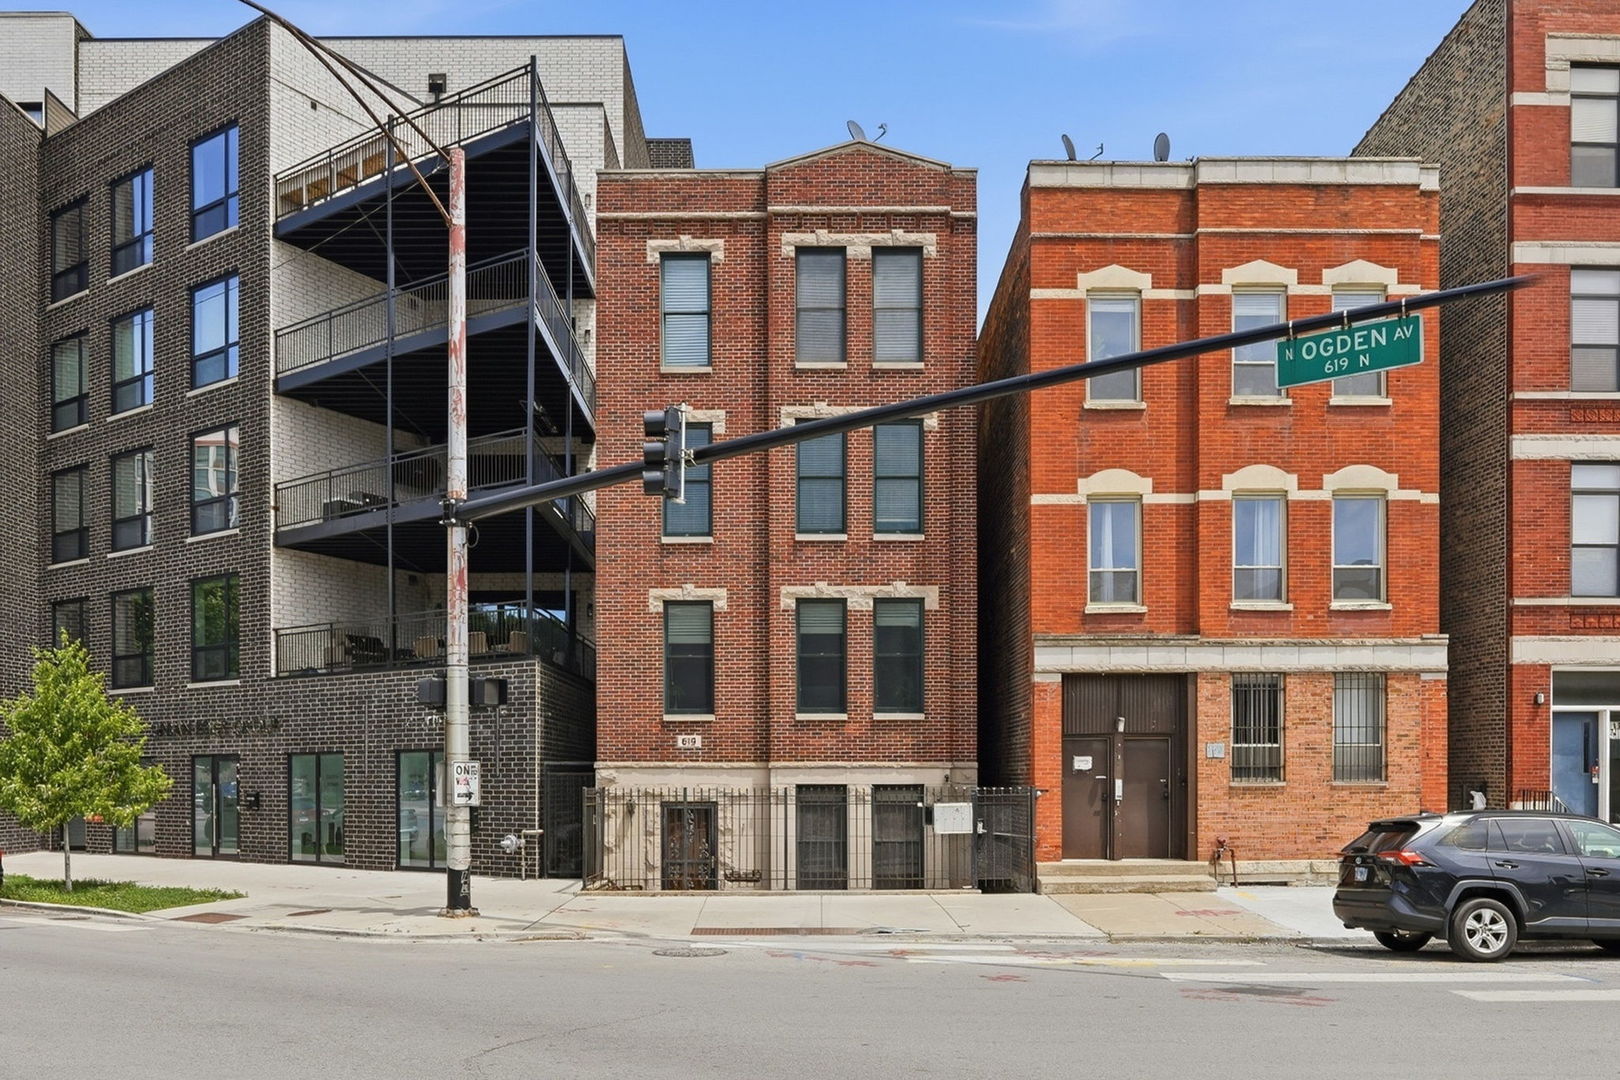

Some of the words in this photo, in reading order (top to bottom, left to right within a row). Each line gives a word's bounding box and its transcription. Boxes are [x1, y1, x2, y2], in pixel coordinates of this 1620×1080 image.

[1285, 348, 1294, 360] N
[1301, 327, 1386, 360] OGDEN
[1393, 325, 1414, 341] AV
[1324, 357, 1349, 373] 619
[1359, 353, 1370, 367] N
